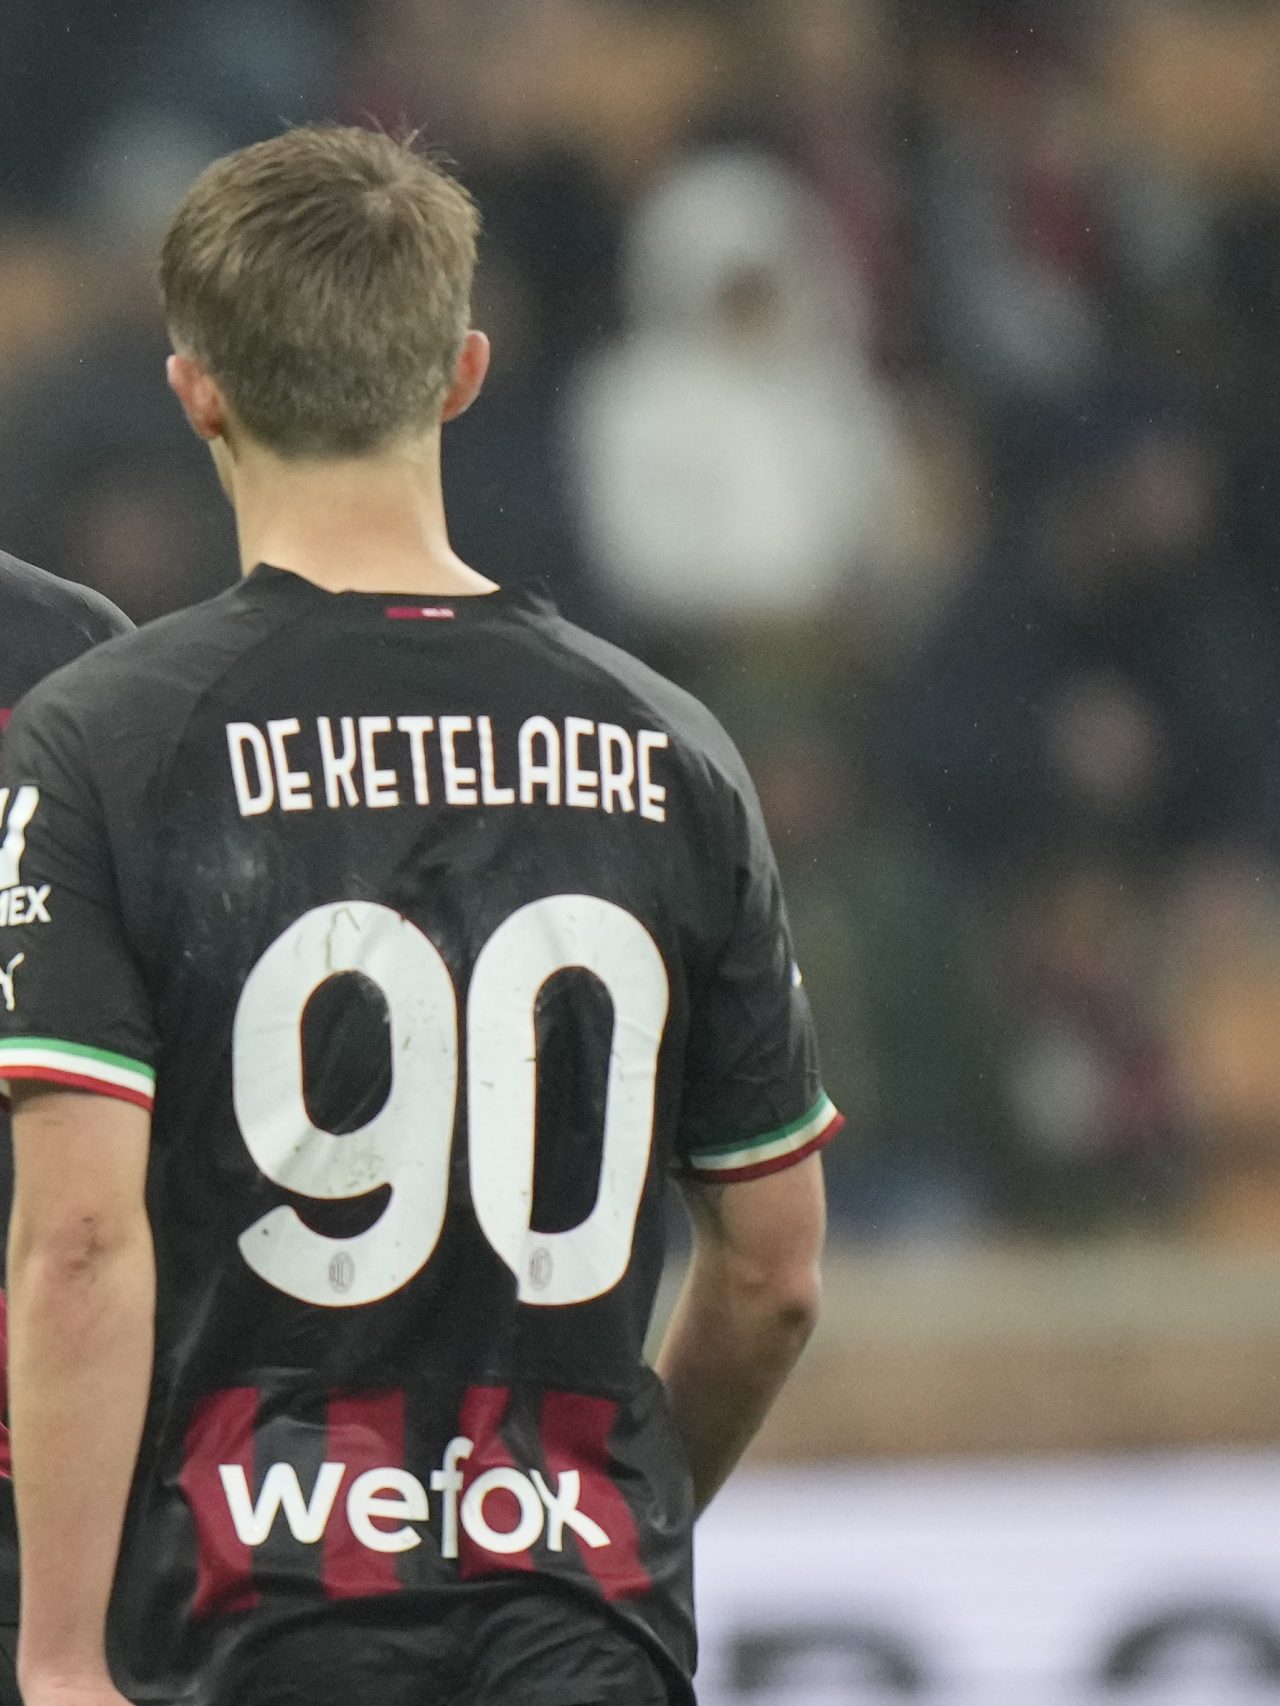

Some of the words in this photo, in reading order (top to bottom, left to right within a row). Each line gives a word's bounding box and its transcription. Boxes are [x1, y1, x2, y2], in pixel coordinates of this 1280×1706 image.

[226, 717, 313, 817] DE
[316, 715, 668, 823] KETELAERE
[232, 893, 669, 1307] 90
[218, 1436, 611, 1559] wefox
